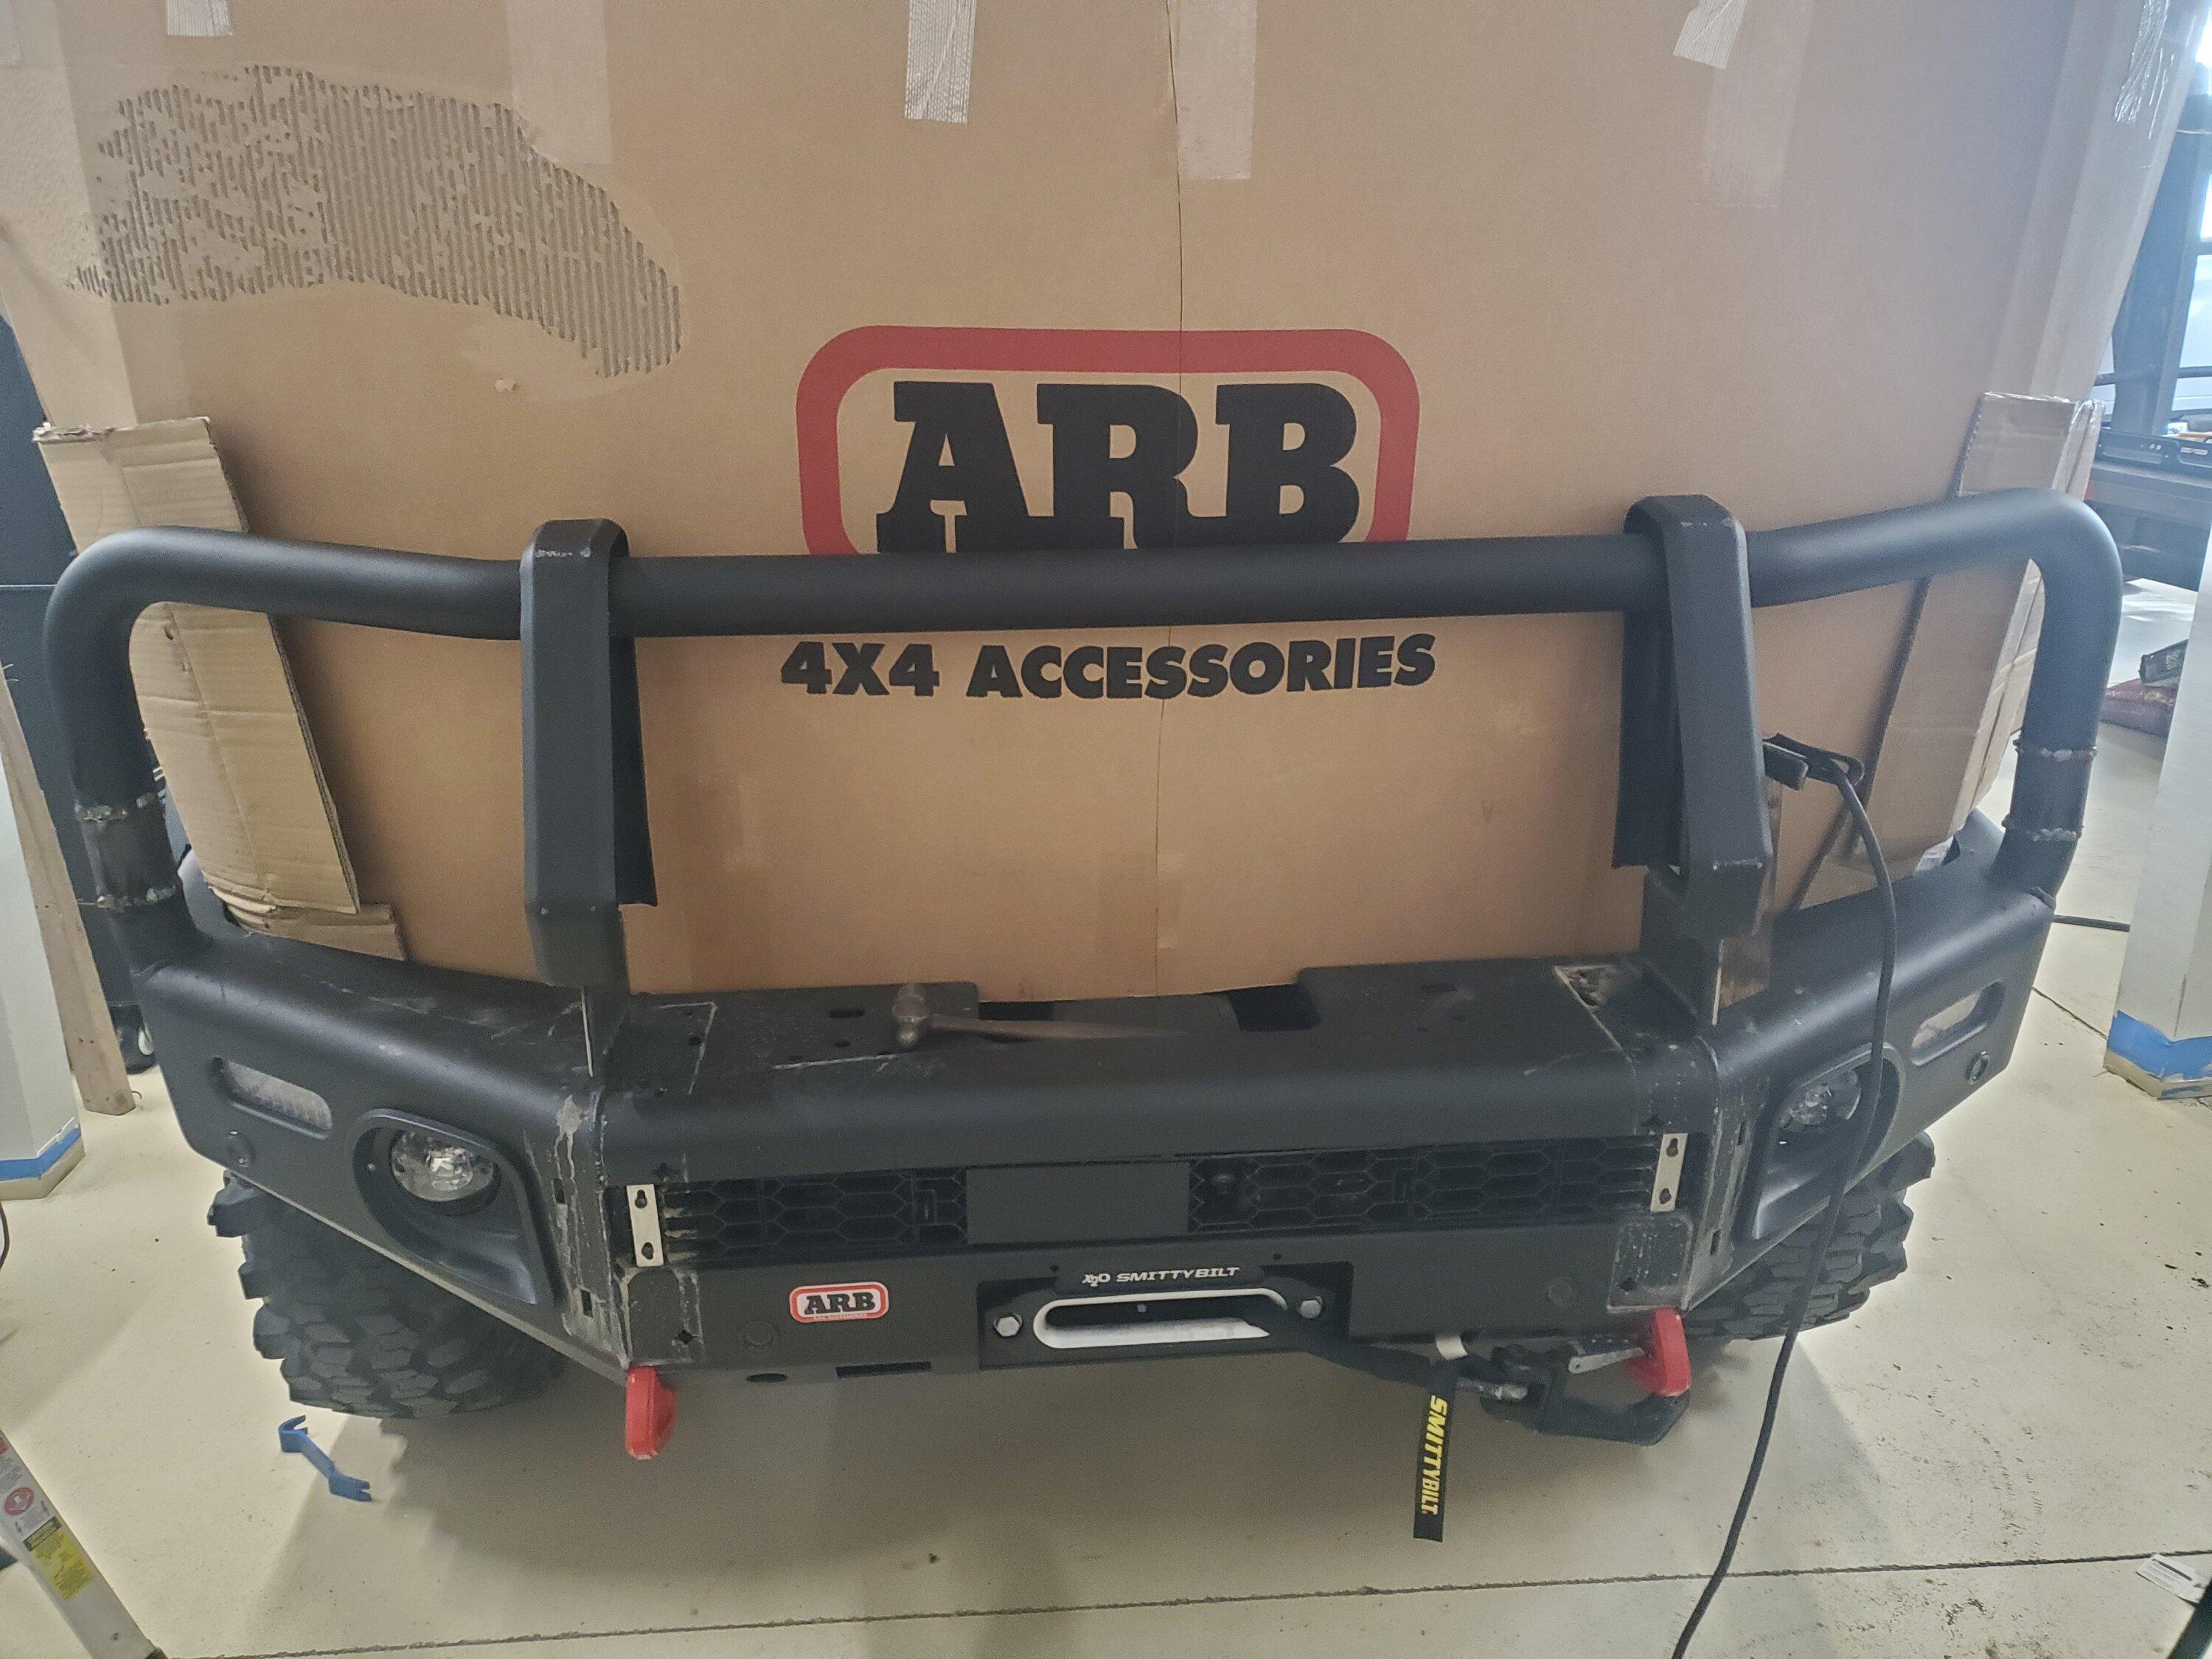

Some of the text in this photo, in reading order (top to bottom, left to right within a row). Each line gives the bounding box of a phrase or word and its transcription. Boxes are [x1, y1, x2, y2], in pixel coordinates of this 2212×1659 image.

[876, 380, 1360, 553] ARB
[780, 633, 1437, 700] 4X4 ACCESSORIES
[804, 1292, 875, 1315] ARB
[1116, 1267, 1240, 1282] SMITTYBILT
[1421, 1395, 1448, 1516] SMITTYBILT
